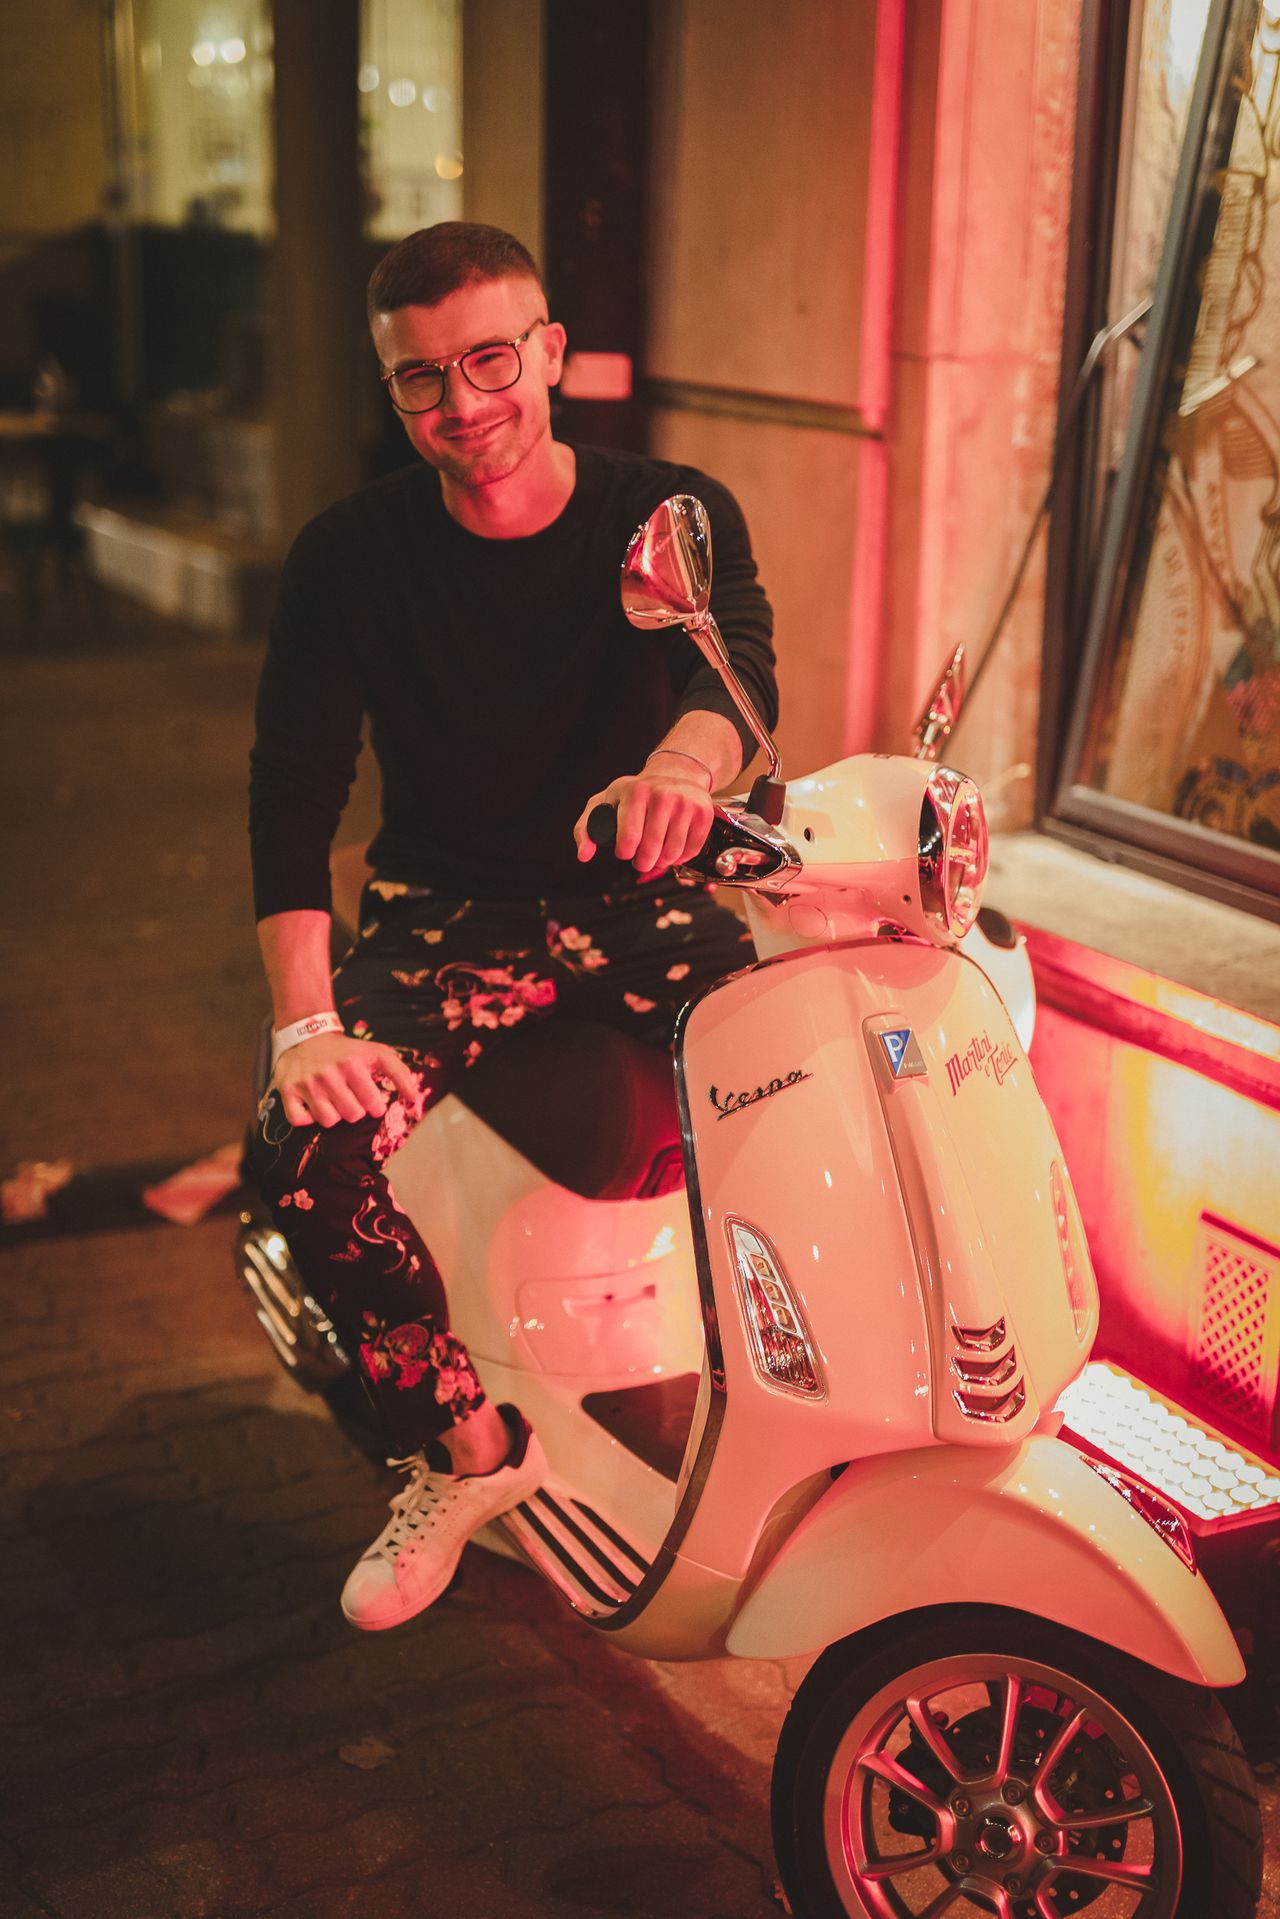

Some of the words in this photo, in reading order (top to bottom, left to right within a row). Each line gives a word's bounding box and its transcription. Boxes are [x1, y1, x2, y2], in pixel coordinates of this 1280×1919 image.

[884, 1035, 903, 1062] P
[945, 1029, 992, 1097] Martini
[709, 1070, 813, 1121] Vespa
